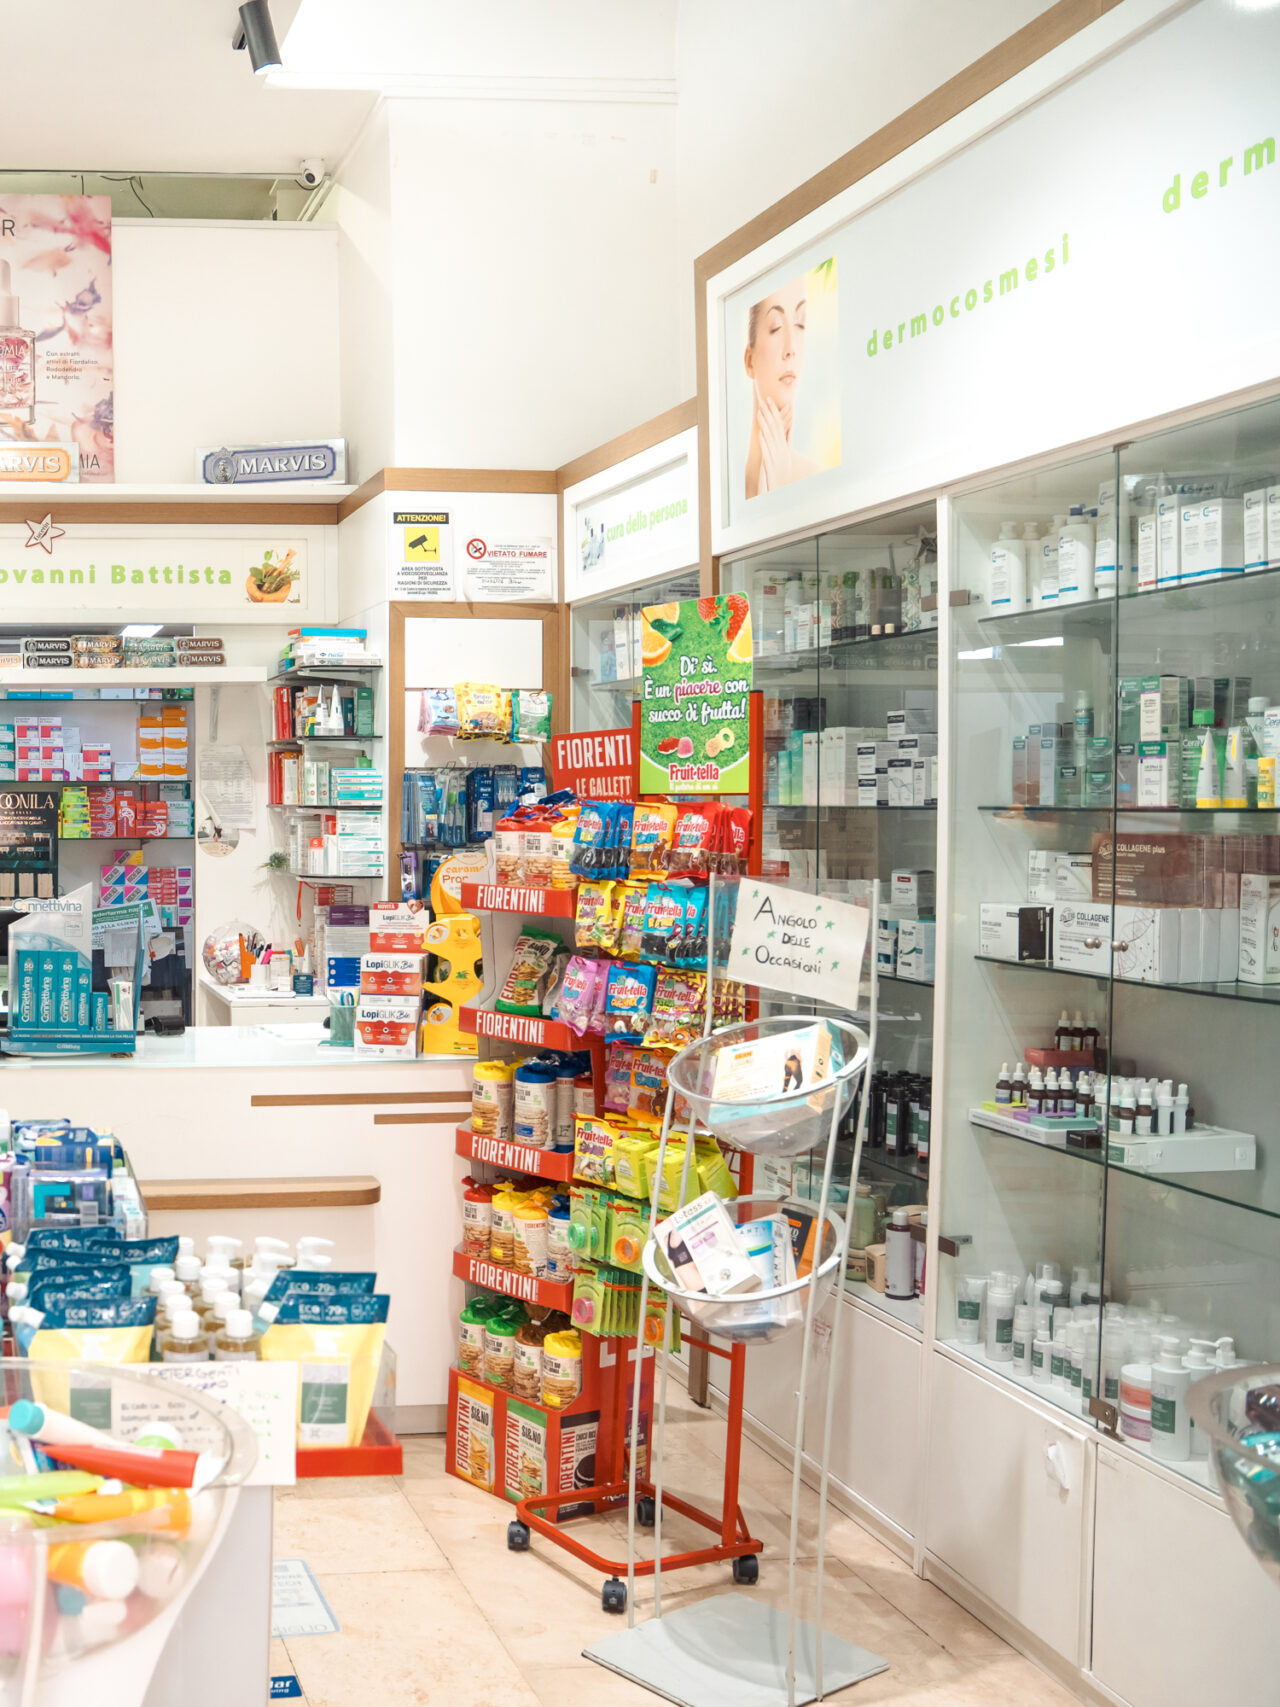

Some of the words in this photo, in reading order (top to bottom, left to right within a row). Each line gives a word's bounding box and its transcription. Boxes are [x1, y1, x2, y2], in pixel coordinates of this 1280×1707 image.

[867, 233, 1070, 357] dermocosmesi
[239, 453, 327, 474] MARVIS
[396, 514, 446, 522] ATTENZIONE!
[606, 518, 624, 542] cura
[626, 510, 648, 536] della
[649, 497, 688, 533] persona
[487, 550, 516, 558] VIETATO
[111, 564, 232, 585] Battista
[37, 642, 67, 650] MARVIS
[87, 641, 117, 649] MARVIS
[644, 674, 654, 700] È
[655, 686, 672, 698] un
[674, 678, 722, 705] piacere
[725, 679, 749, 694] con
[648, 708, 683, 723] succo
[685, 702, 698, 721] di
[700, 697, 747, 727] frutta!
[576, 778, 587, 797] LE
[589, 775, 632, 797] GALLETT
[1116, 844, 1151, 853] COLLAGENE
[1152, 845, 1165, 854] plus
[13, 901, 81, 913] Connettivina
[477, 885, 543, 913] FIORENTINI
[1076, 912, 1110, 923] COLLAGENE
[21, 976, 31, 1023] Connettivina
[40, 976, 50, 1023] Connettivina
[60, 976, 70, 1023] Connettivina
[475, 1011, 543, 1045] FIORENTINI
[472, 1136, 538, 1173] FIORENTINI
[470, 1259, 537, 1302] FIORENTINI
[65, 1308, 88, 1319] ECO
[299, 1304, 322, 1316] ECO
[456, 1397, 470, 1471] FIORENTINI
[506, 1415, 520, 1491] FIORENTINI
